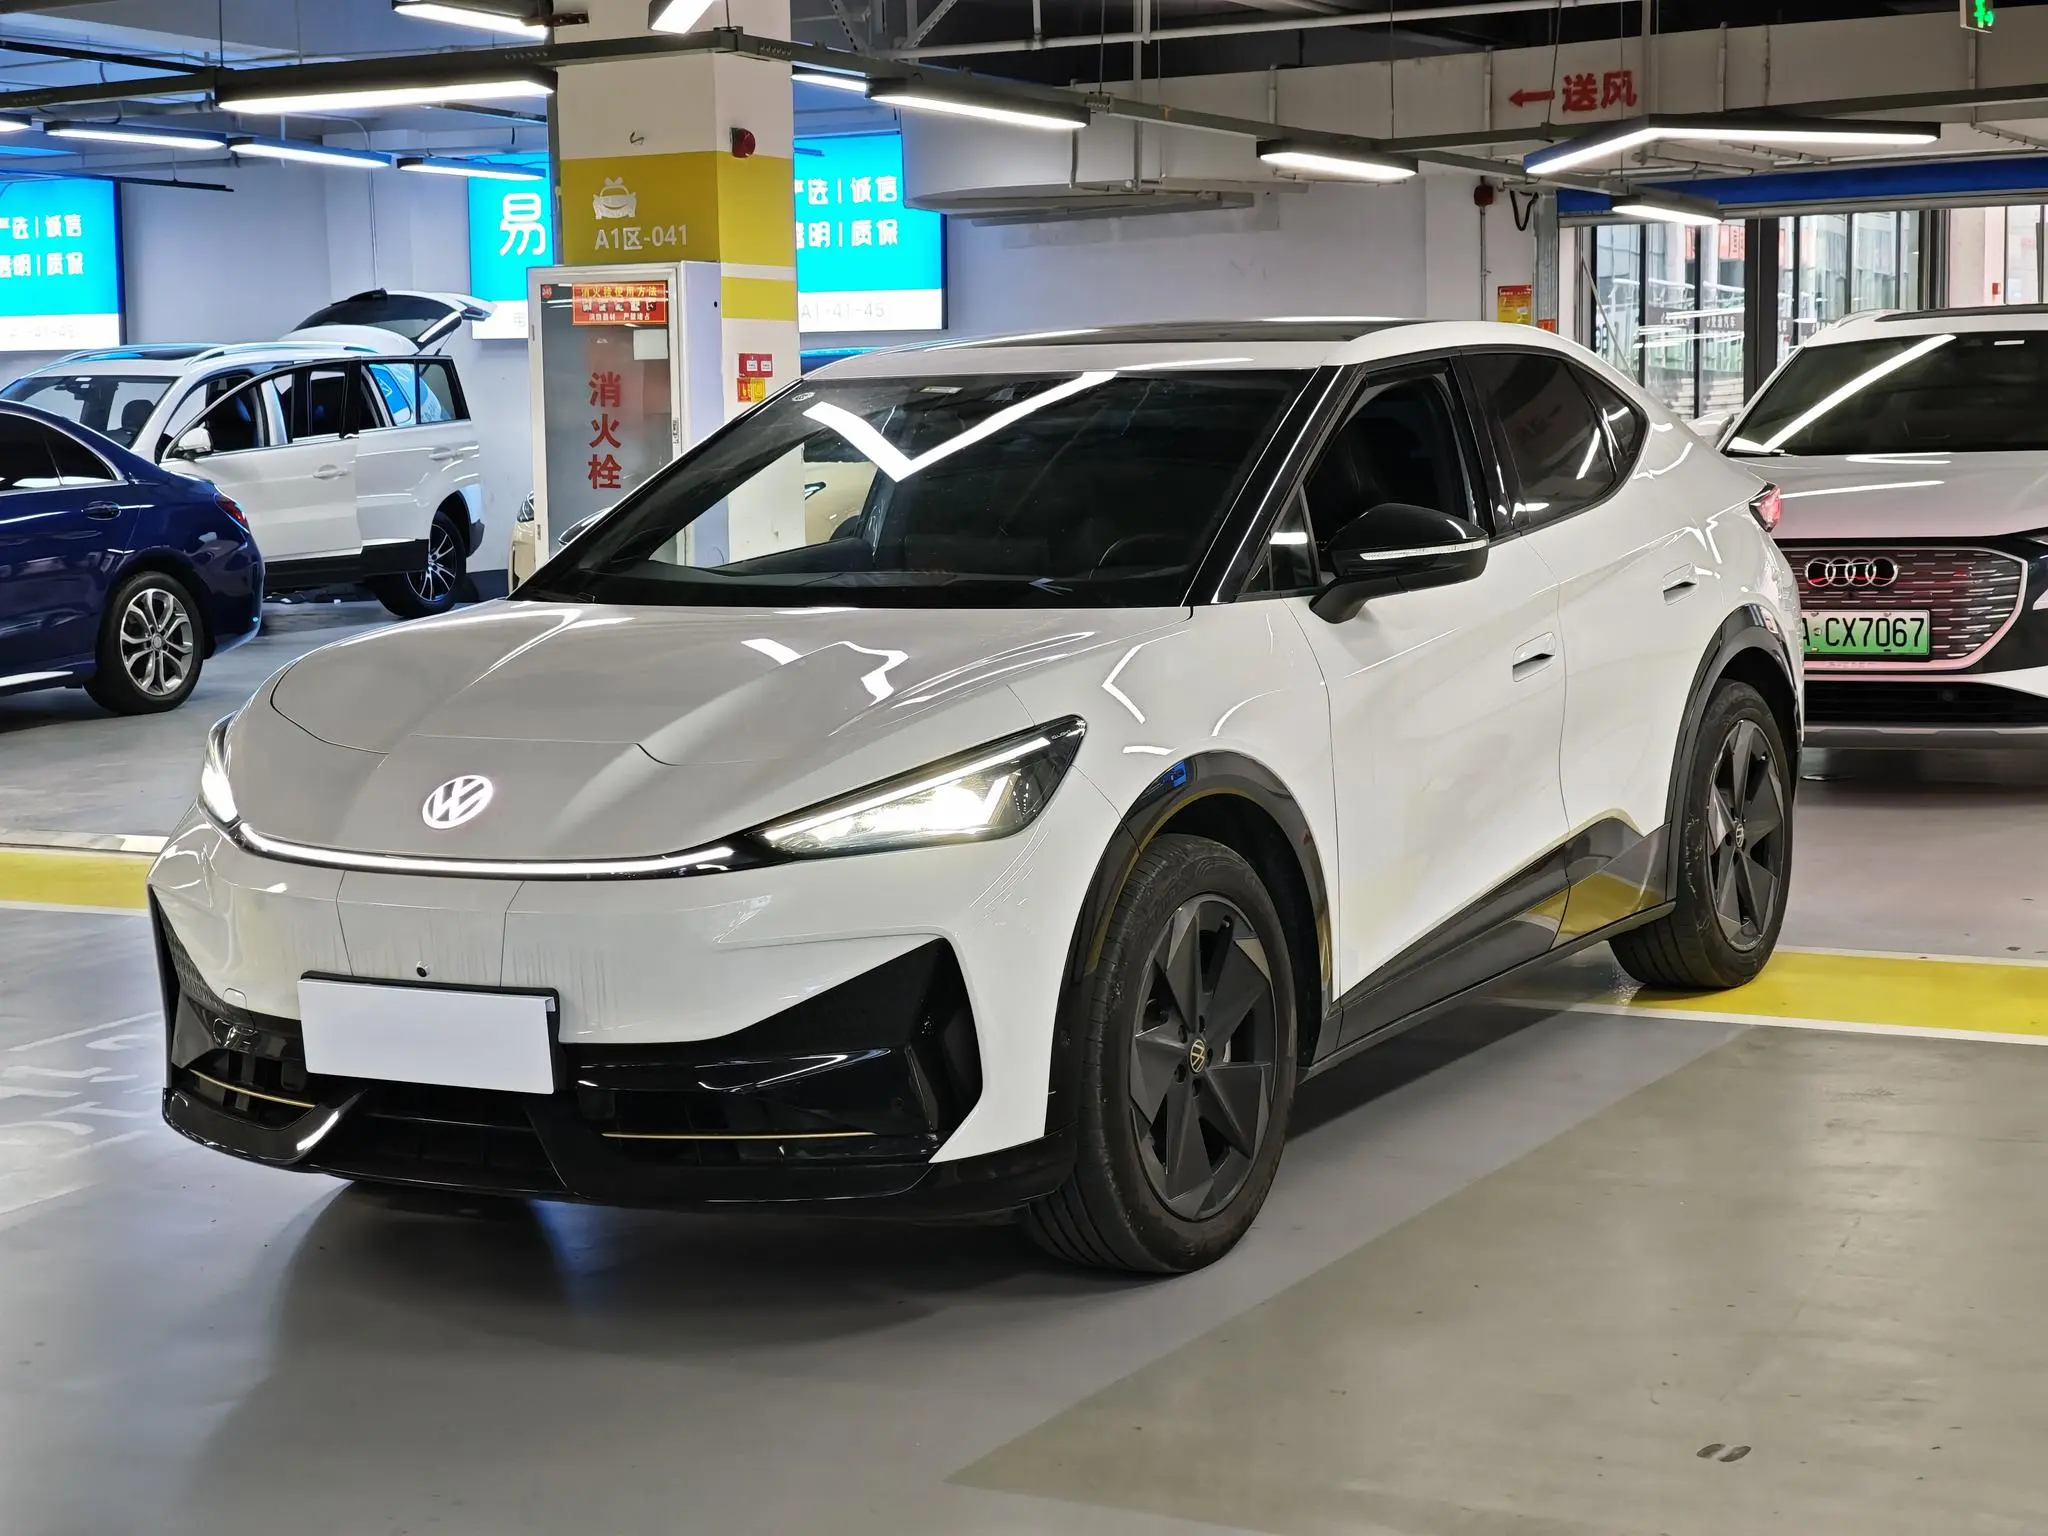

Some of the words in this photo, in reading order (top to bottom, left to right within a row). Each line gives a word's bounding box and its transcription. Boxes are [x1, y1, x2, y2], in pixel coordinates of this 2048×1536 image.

[1562, 70, 1637, 113] 送风
[499, 192, 547, 256] 易
[594, 224, 687, 251] A1区-041
[587, 371, 623, 490] 消火栓
[1825, 617, 1925, 647] CX7067
